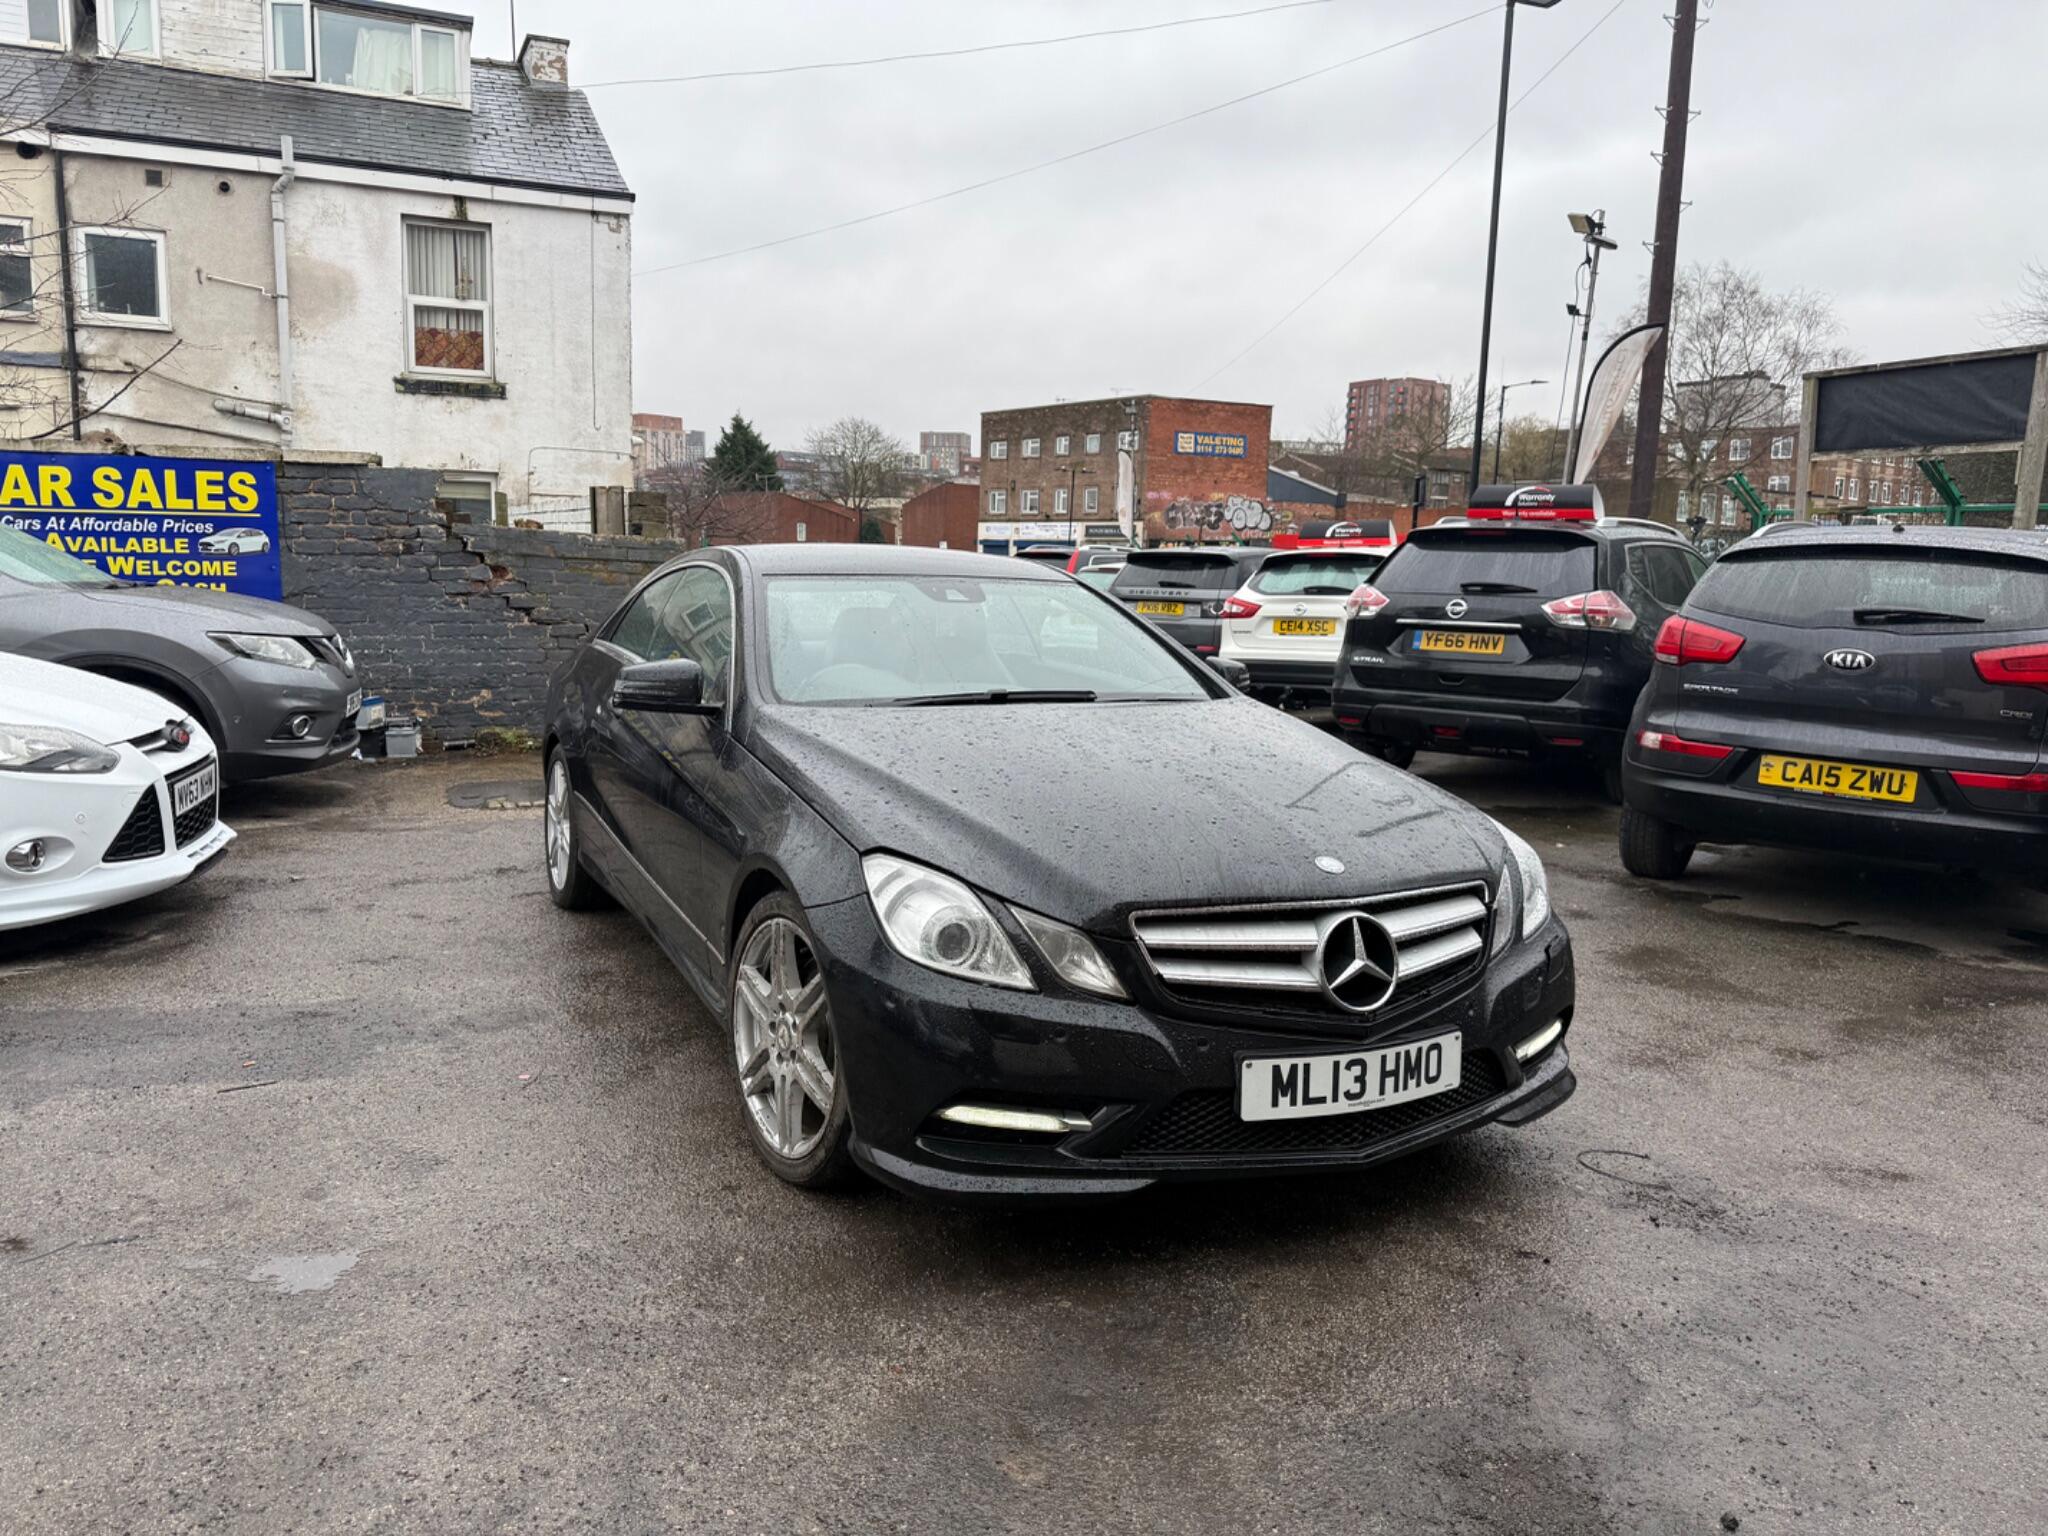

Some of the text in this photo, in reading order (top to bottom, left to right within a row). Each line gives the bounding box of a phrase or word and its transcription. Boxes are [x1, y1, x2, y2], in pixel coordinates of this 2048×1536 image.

[1196, 434, 1244, 446] VALETING
[92, 466, 259, 512] SALES
[1518, 493, 1556, 502] Warranty
[1, 515, 214, 534] Cars At Affordable Prices
[46, 532, 190, 554] AVAILABLE
[106, 555, 238, 577] WELCOME
[1129, 588, 1190, 596] DISCOVERY
[1280, 620, 1329, 632] CE14 XSC
[1425, 632, 1502, 650] YF66 HNV
[1832, 652, 1867, 668] KIA
[1781, 761, 1842, 788] CA15
[1849, 768, 1905, 796] ZWU
[1271, 1042, 1443, 1109] ML13 HMO
